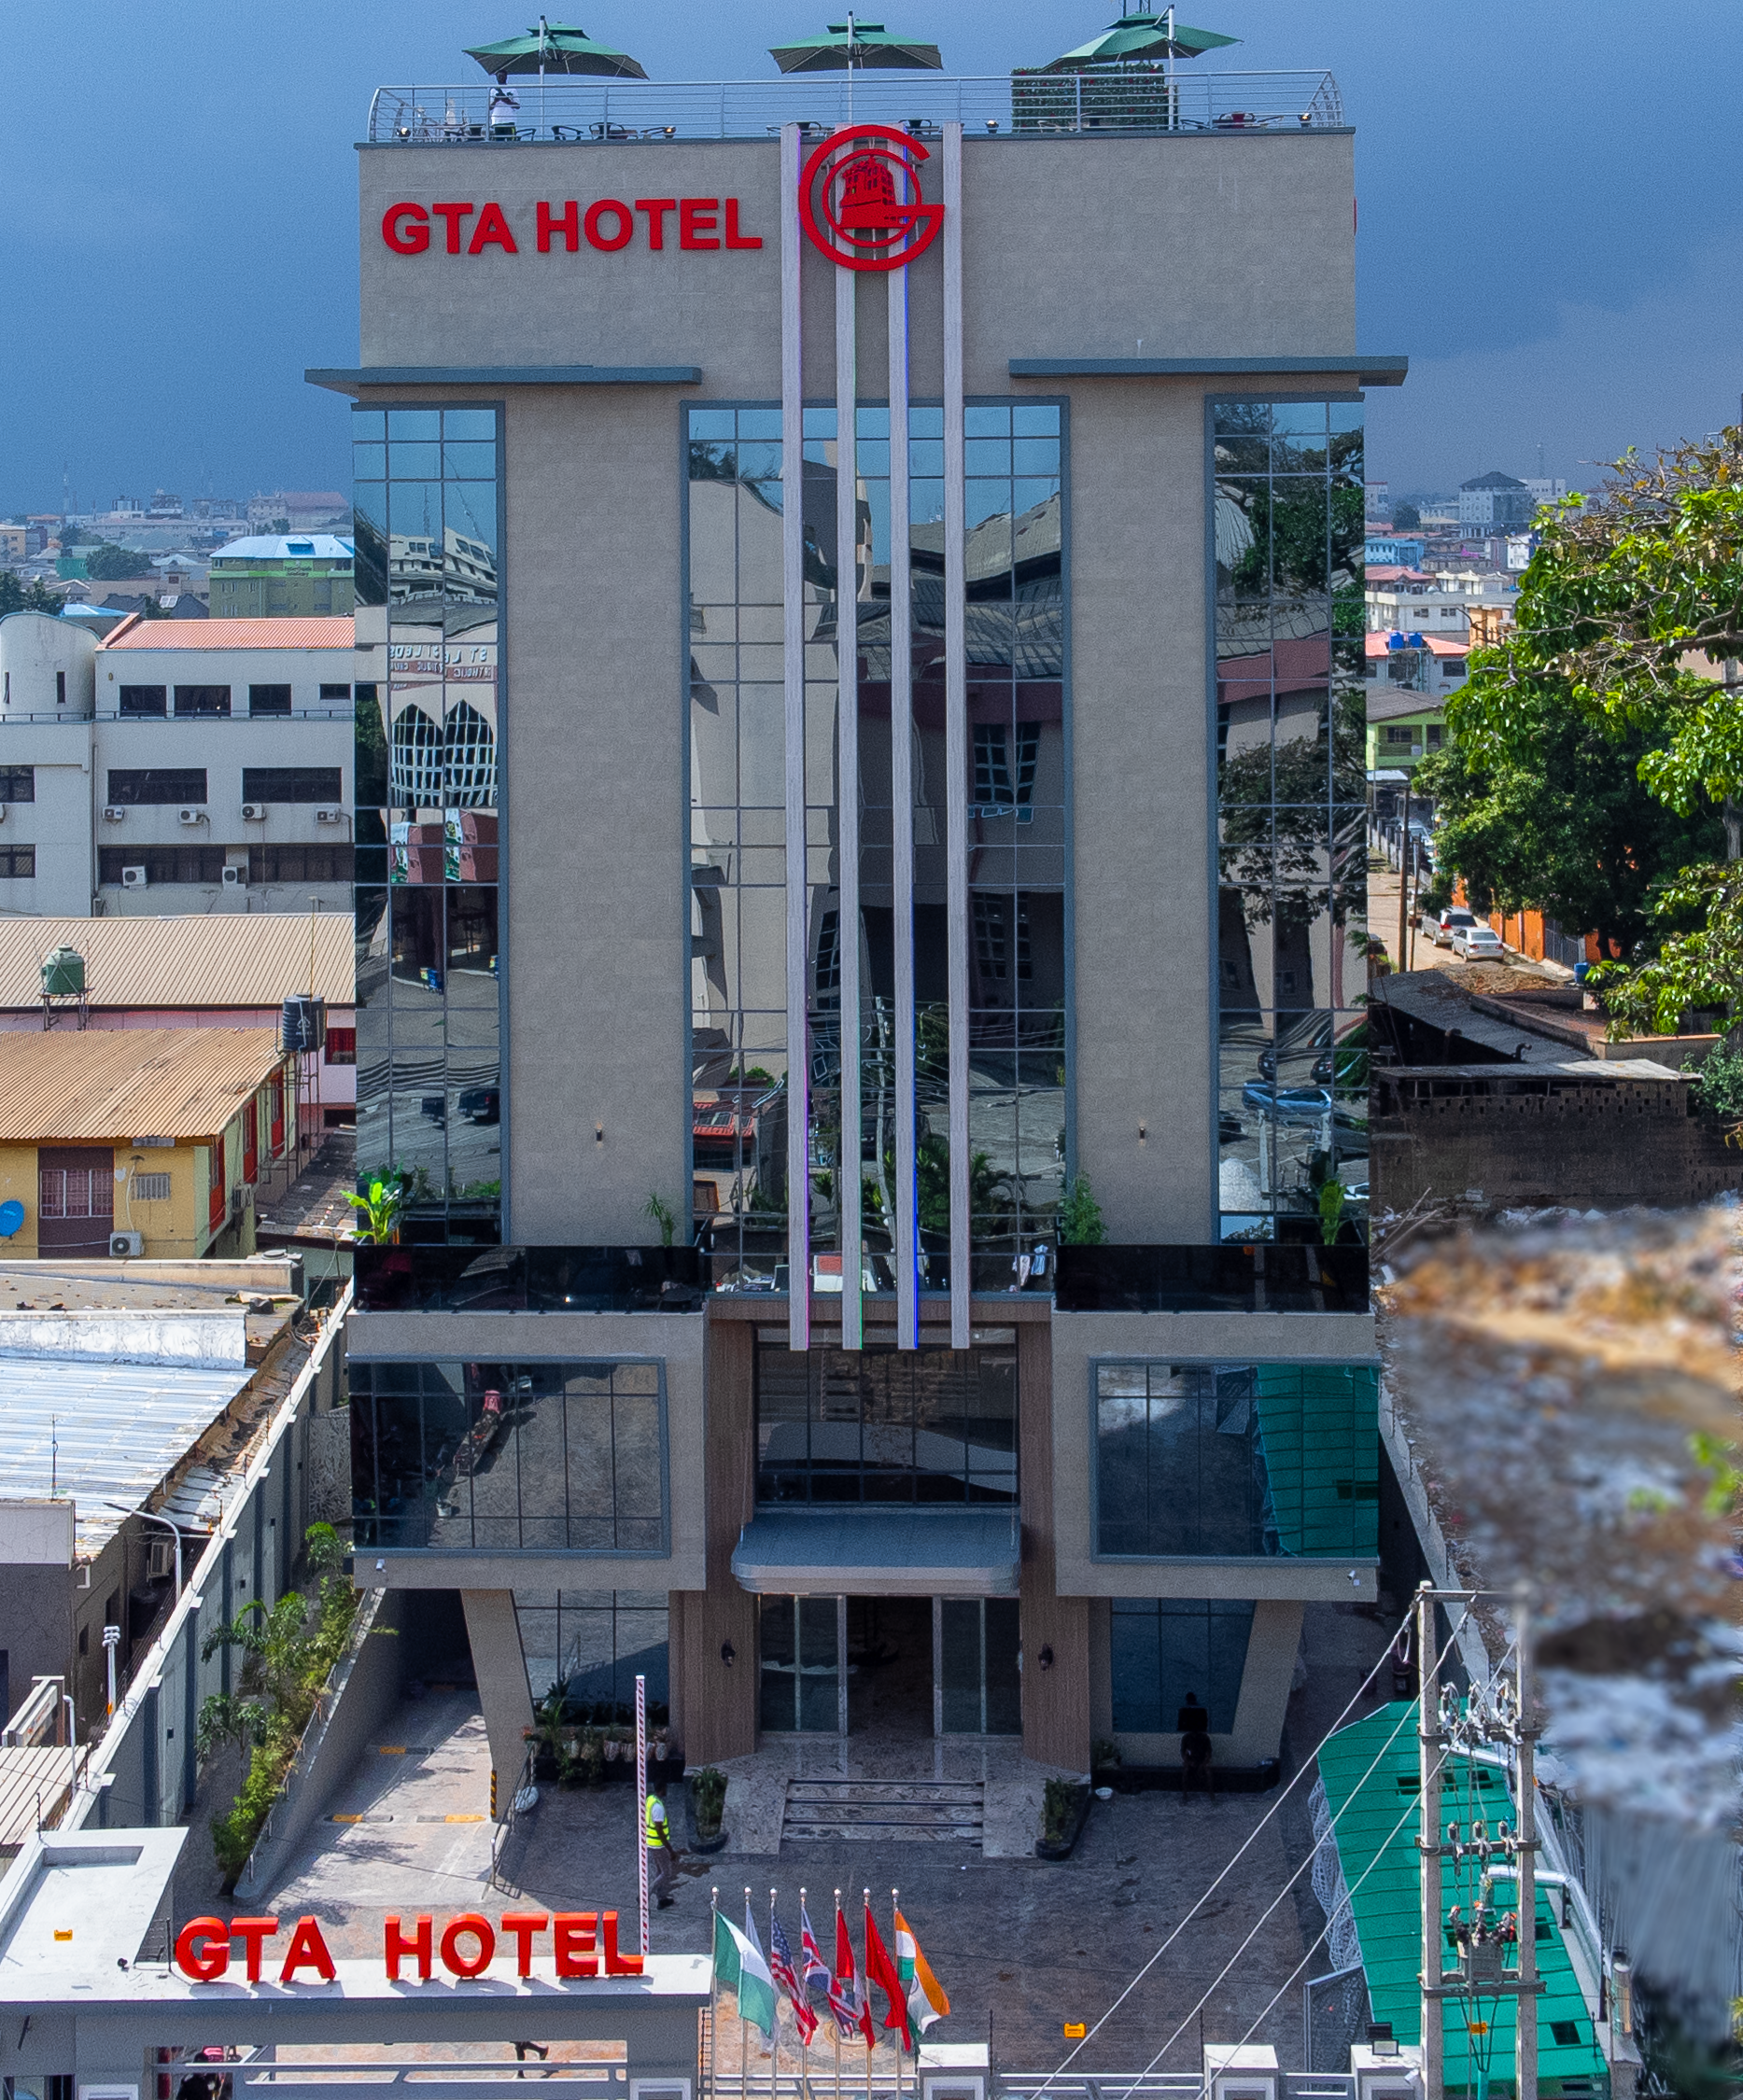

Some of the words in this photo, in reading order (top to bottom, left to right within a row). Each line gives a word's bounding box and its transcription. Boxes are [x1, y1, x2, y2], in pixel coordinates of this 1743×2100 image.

[383, 202, 518, 254] GTA
[536, 198, 763, 252] HOTEL
[175, 1915, 336, 1982] GTA
[385, 1911, 645, 1981] HOTEL
